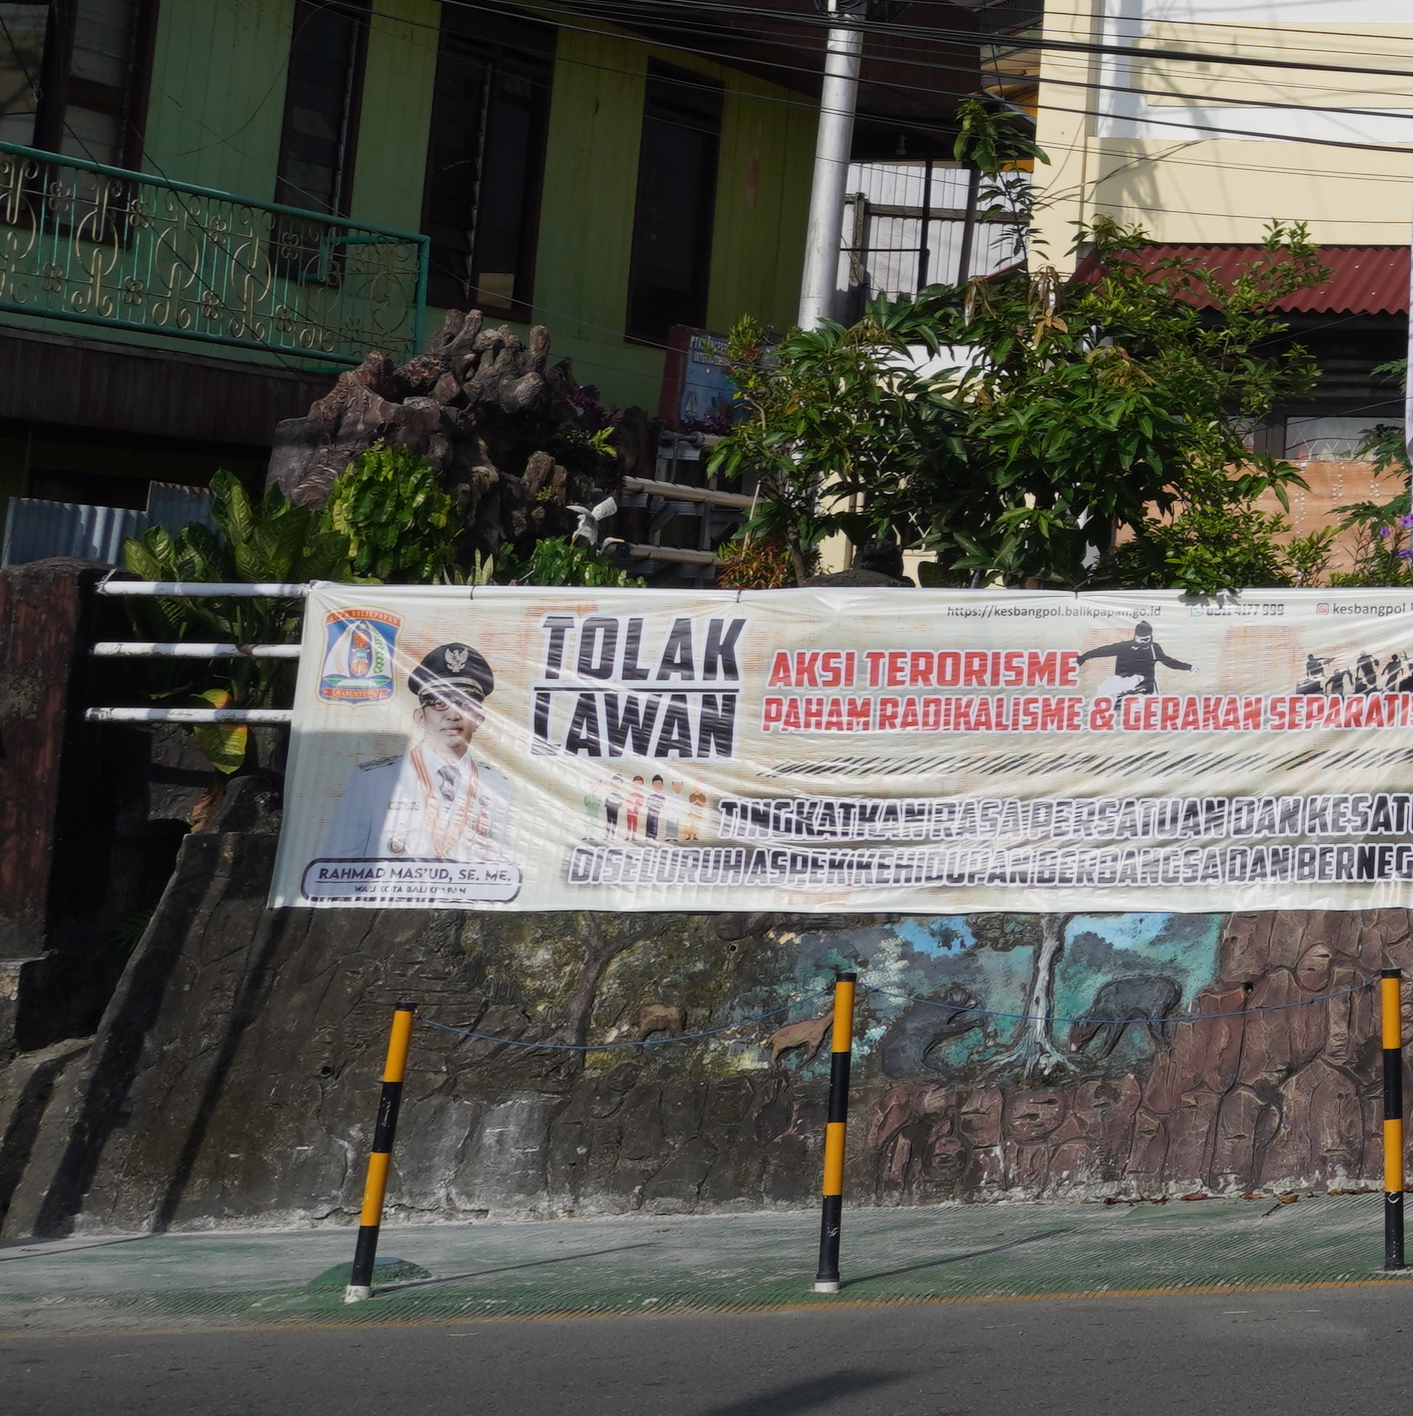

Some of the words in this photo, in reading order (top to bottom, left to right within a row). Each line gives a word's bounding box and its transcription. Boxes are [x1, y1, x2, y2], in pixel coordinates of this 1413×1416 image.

[947, 606, 1161, 619] https://kesbangpol.balikpapan.go.id
[1262, 603, 1285, 616] 999
[541, 615, 748, 681] TOLAK
[767, 651, 855, 687] AKSI
[864, 651, 1080, 687] TERORISME
[529, 692, 737, 758] LAWAN
[762, 697, 871, 732] PAHAM
[879, 697, 1083, 731] RADIKALISME
[1089, 697, 1114, 731] &
[1121, 696, 1262, 731] GERAKAN
[719, 799, 928, 839] TINGKATKAN
[931, 800, 1023, 839] RASA
[1029, 797, 1227, 839] PERSATUAN
[1229, 796, 1303, 837] DAN
[318, 868, 386, 880] RAHMAD
[389, 868, 453, 883] MAS'UD,
[457, 869, 480, 880] SE.
[484, 870, 511, 882] ME.
[569, 847, 746, 884] DISELURUH
[747, 848, 849, 885] ASPEK
[851, 849, 1033, 885] KEHIDUPAN
[1037, 847, 1221, 885] BERBANGSA
[1226, 844, 1296, 885] DAN
